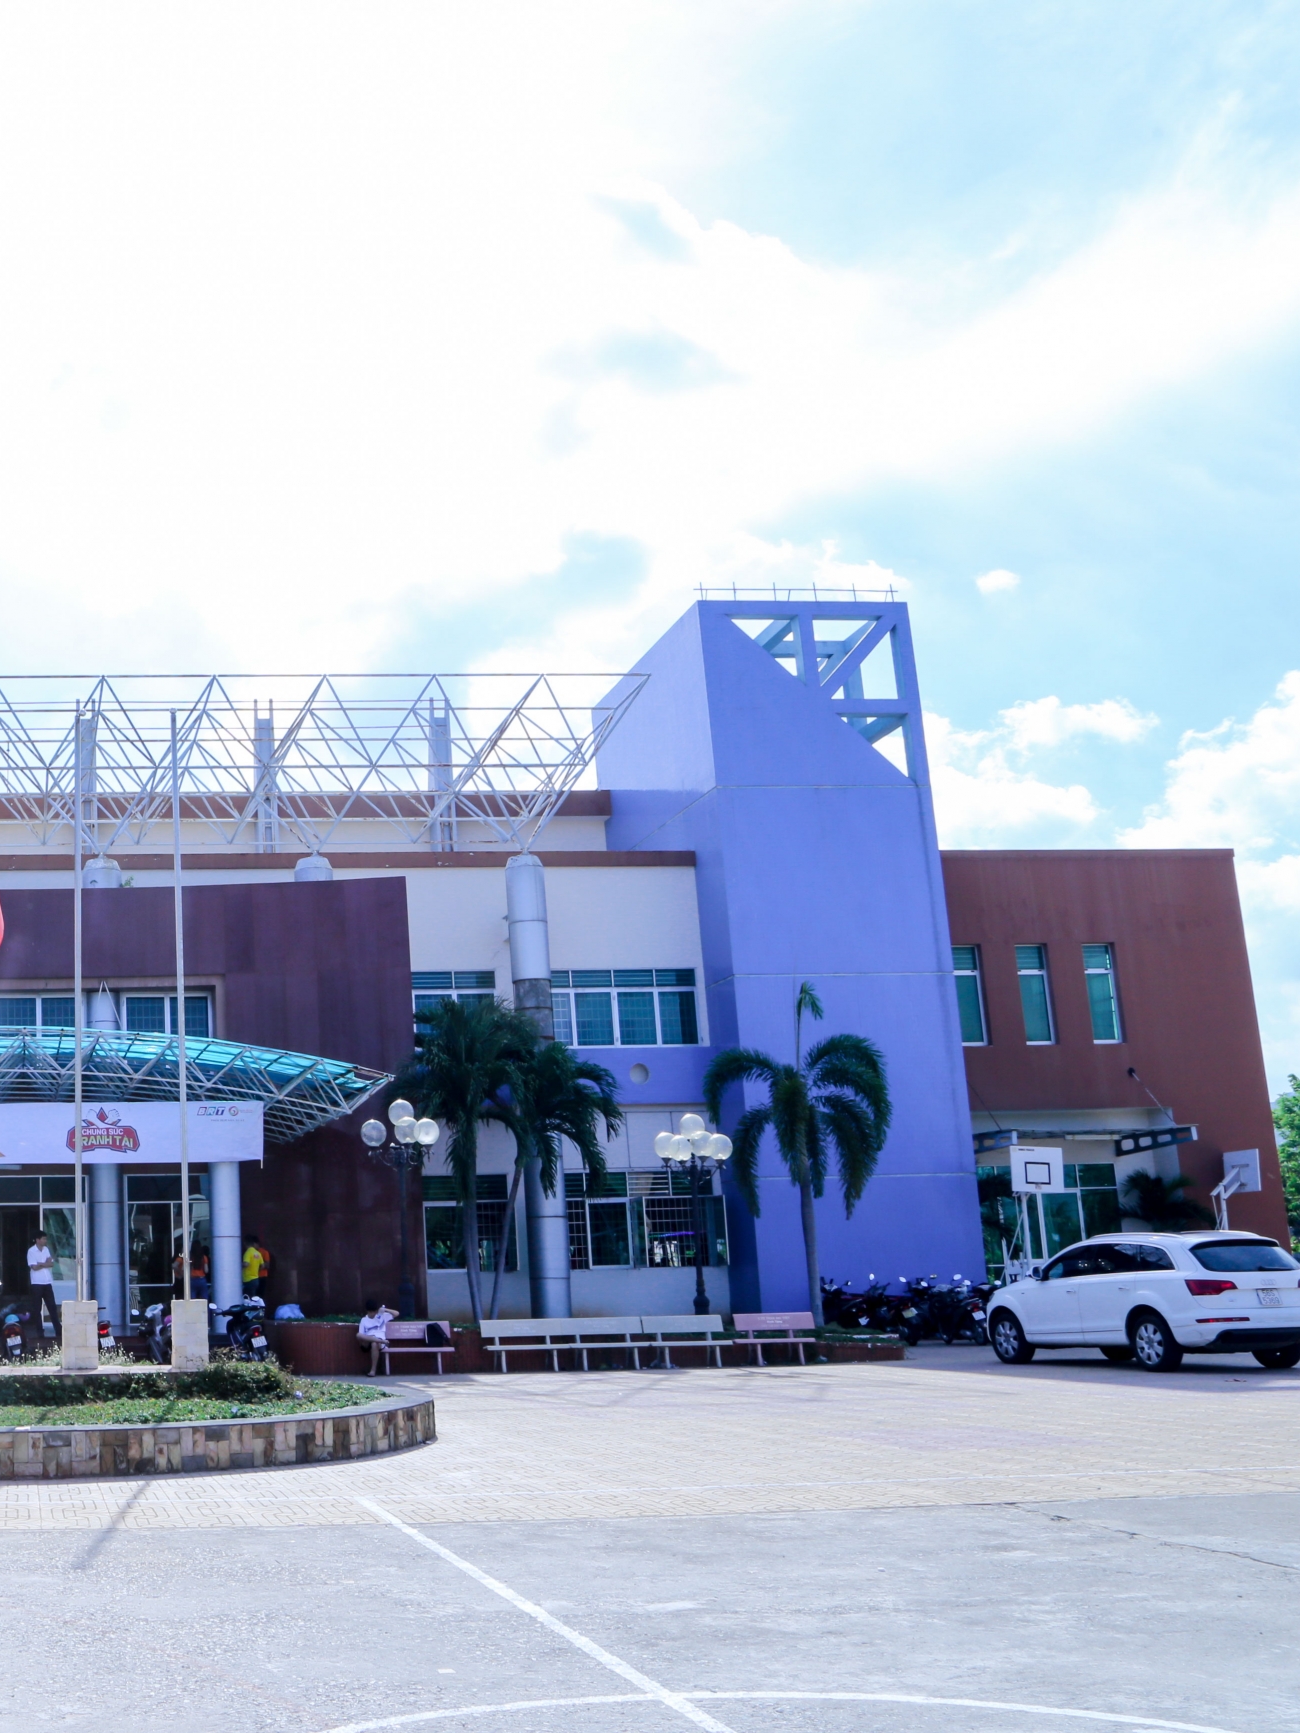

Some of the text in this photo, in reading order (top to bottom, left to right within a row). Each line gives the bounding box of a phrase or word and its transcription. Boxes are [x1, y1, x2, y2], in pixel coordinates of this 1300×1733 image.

[197, 1106, 227, 1116] BRT
[81, 1128, 107, 1136] CHUNG
[72, 1135, 112, 1146] RANH
